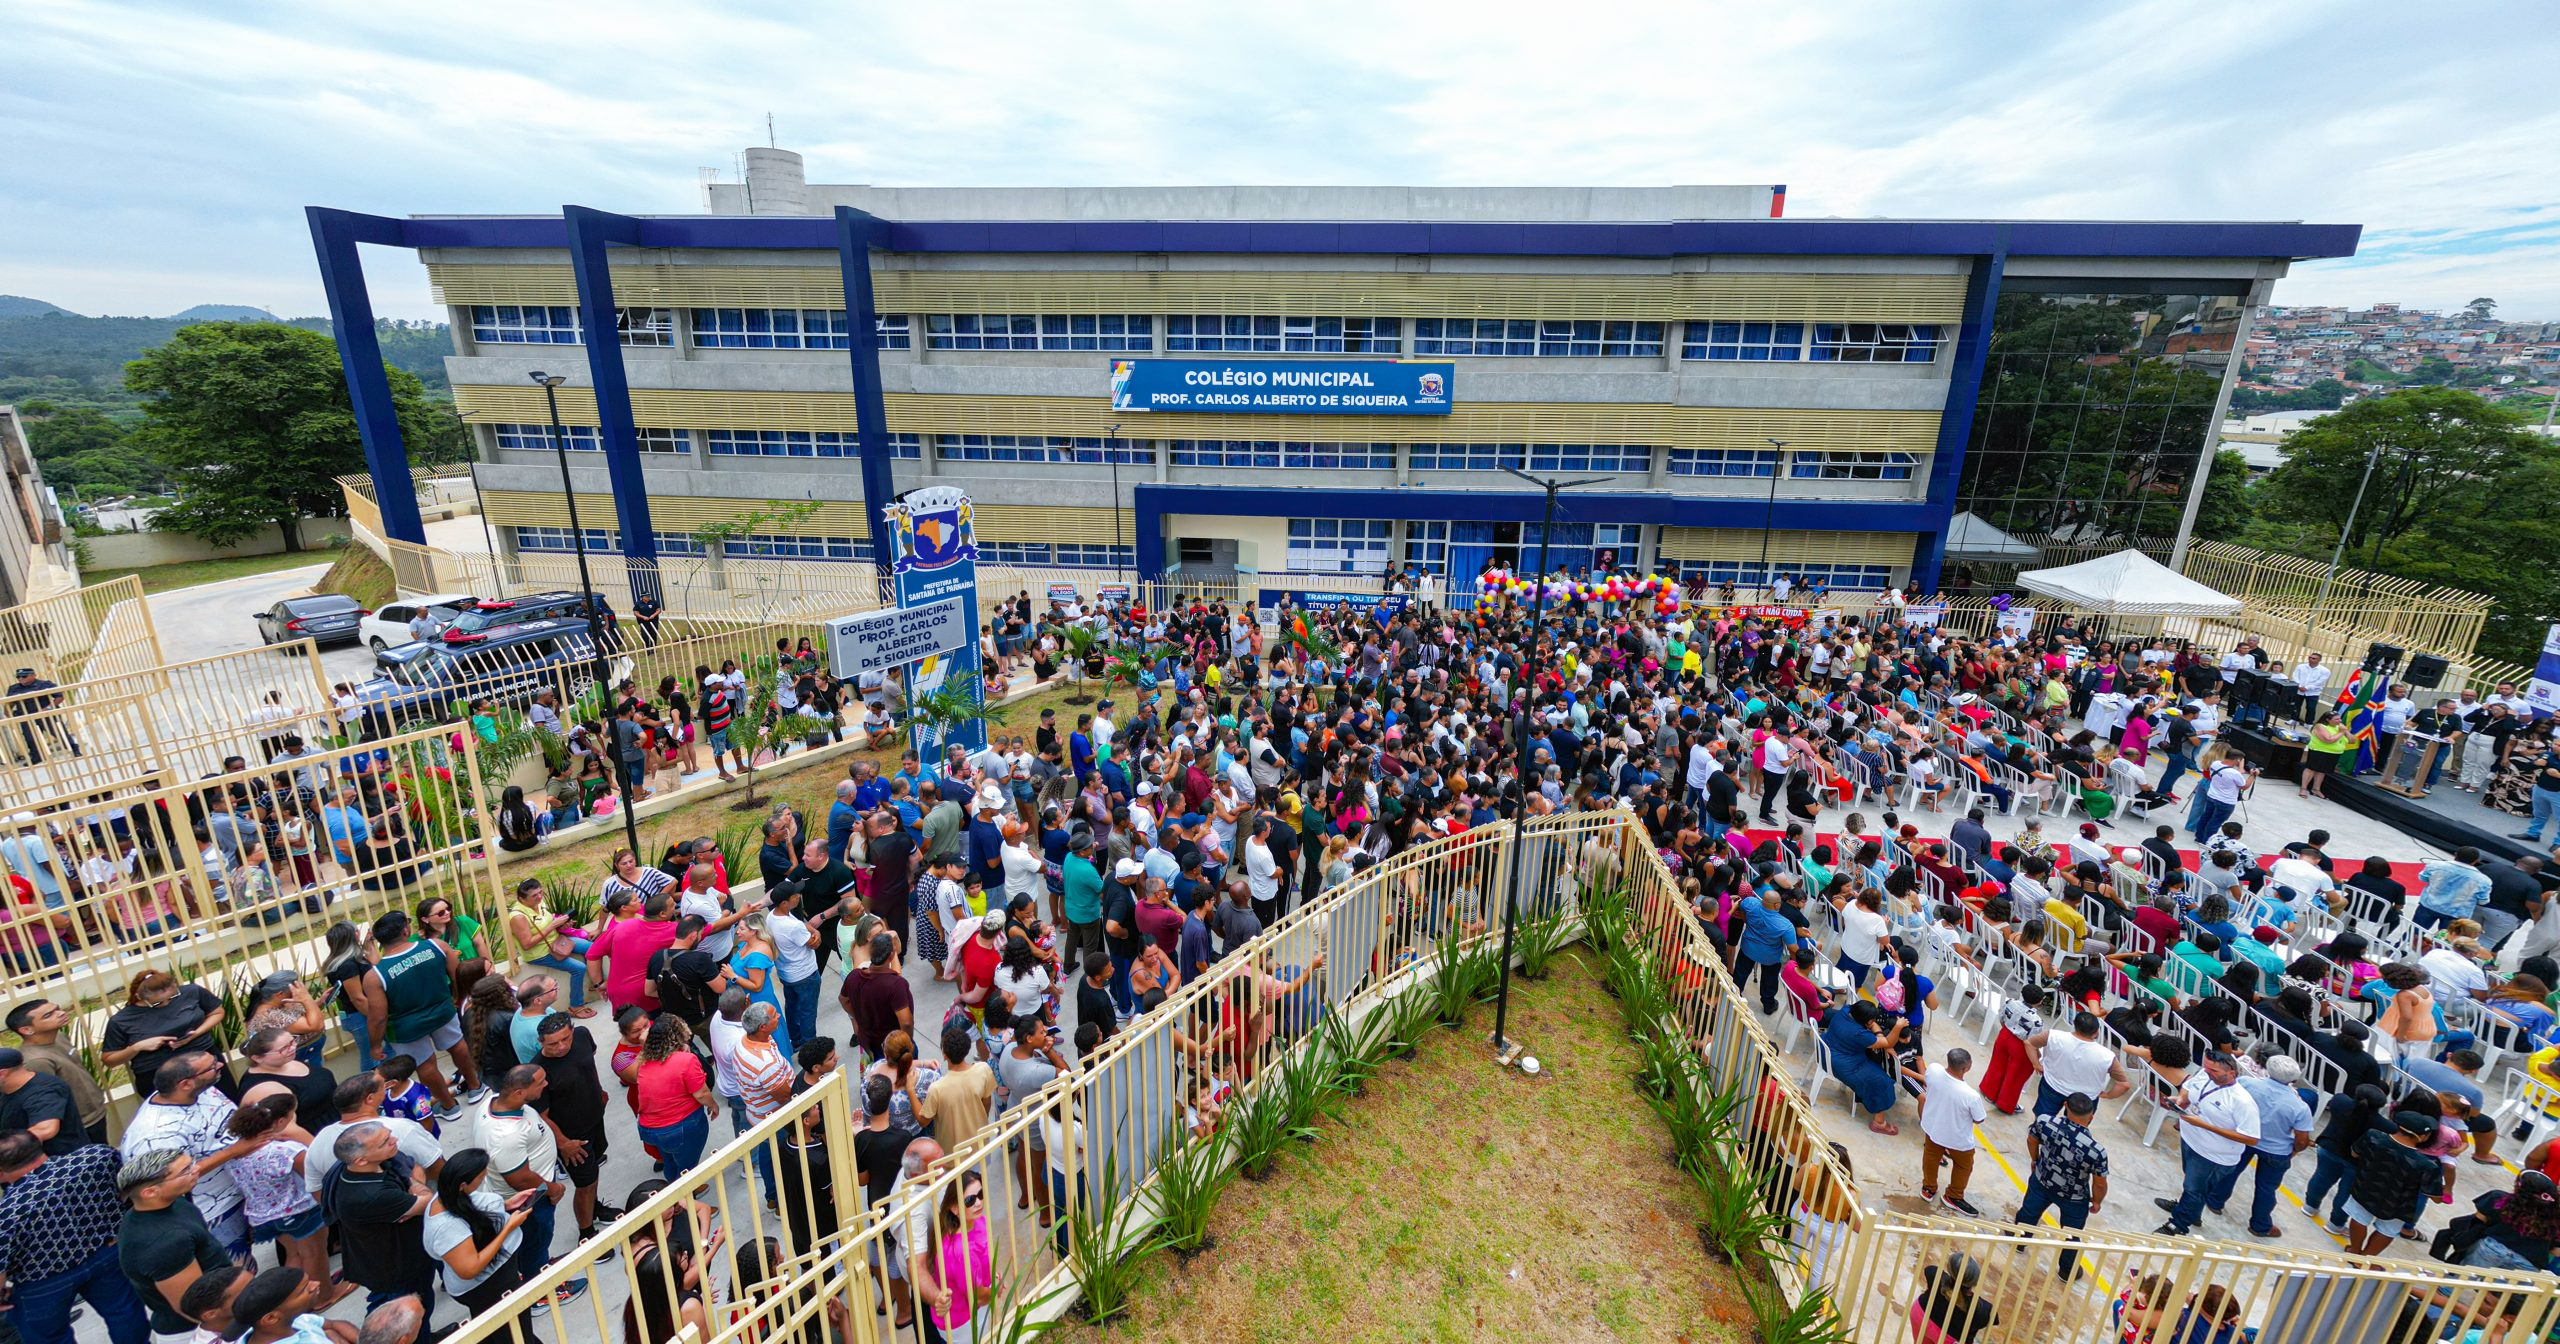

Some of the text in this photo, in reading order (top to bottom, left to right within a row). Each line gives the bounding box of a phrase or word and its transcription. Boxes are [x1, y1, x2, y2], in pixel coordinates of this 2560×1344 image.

[1185, 367, 1375, 387] COLÉGIO MUNICIPAL
[1151, 393, 1191, 404] PROF.
[1195, 393, 1250, 405] CARLOS
[1253, 394, 1317, 406] ALBERTO
[1320, 395, 1339, 406] DE
[1342, 395, 1408, 407] SIQUEIRA
[908, 580, 975, 602] SANTANA DE PARNAÍBA
[923, 579, 952, 591] PREFEITURA
[840, 602, 956, 636] COLÉGIO MUNICIPAL
[1765, 605, 1780, 616] NÃO
[859, 615, 948, 644] PROF. CARLOS
[876, 631, 932, 654] ALBERTO
[861, 641, 941, 668] DE SIQUEIRA
[493, 678, 540, 694] MUNICIPAL
[388, 948, 435, 979] PALMEIRAS
